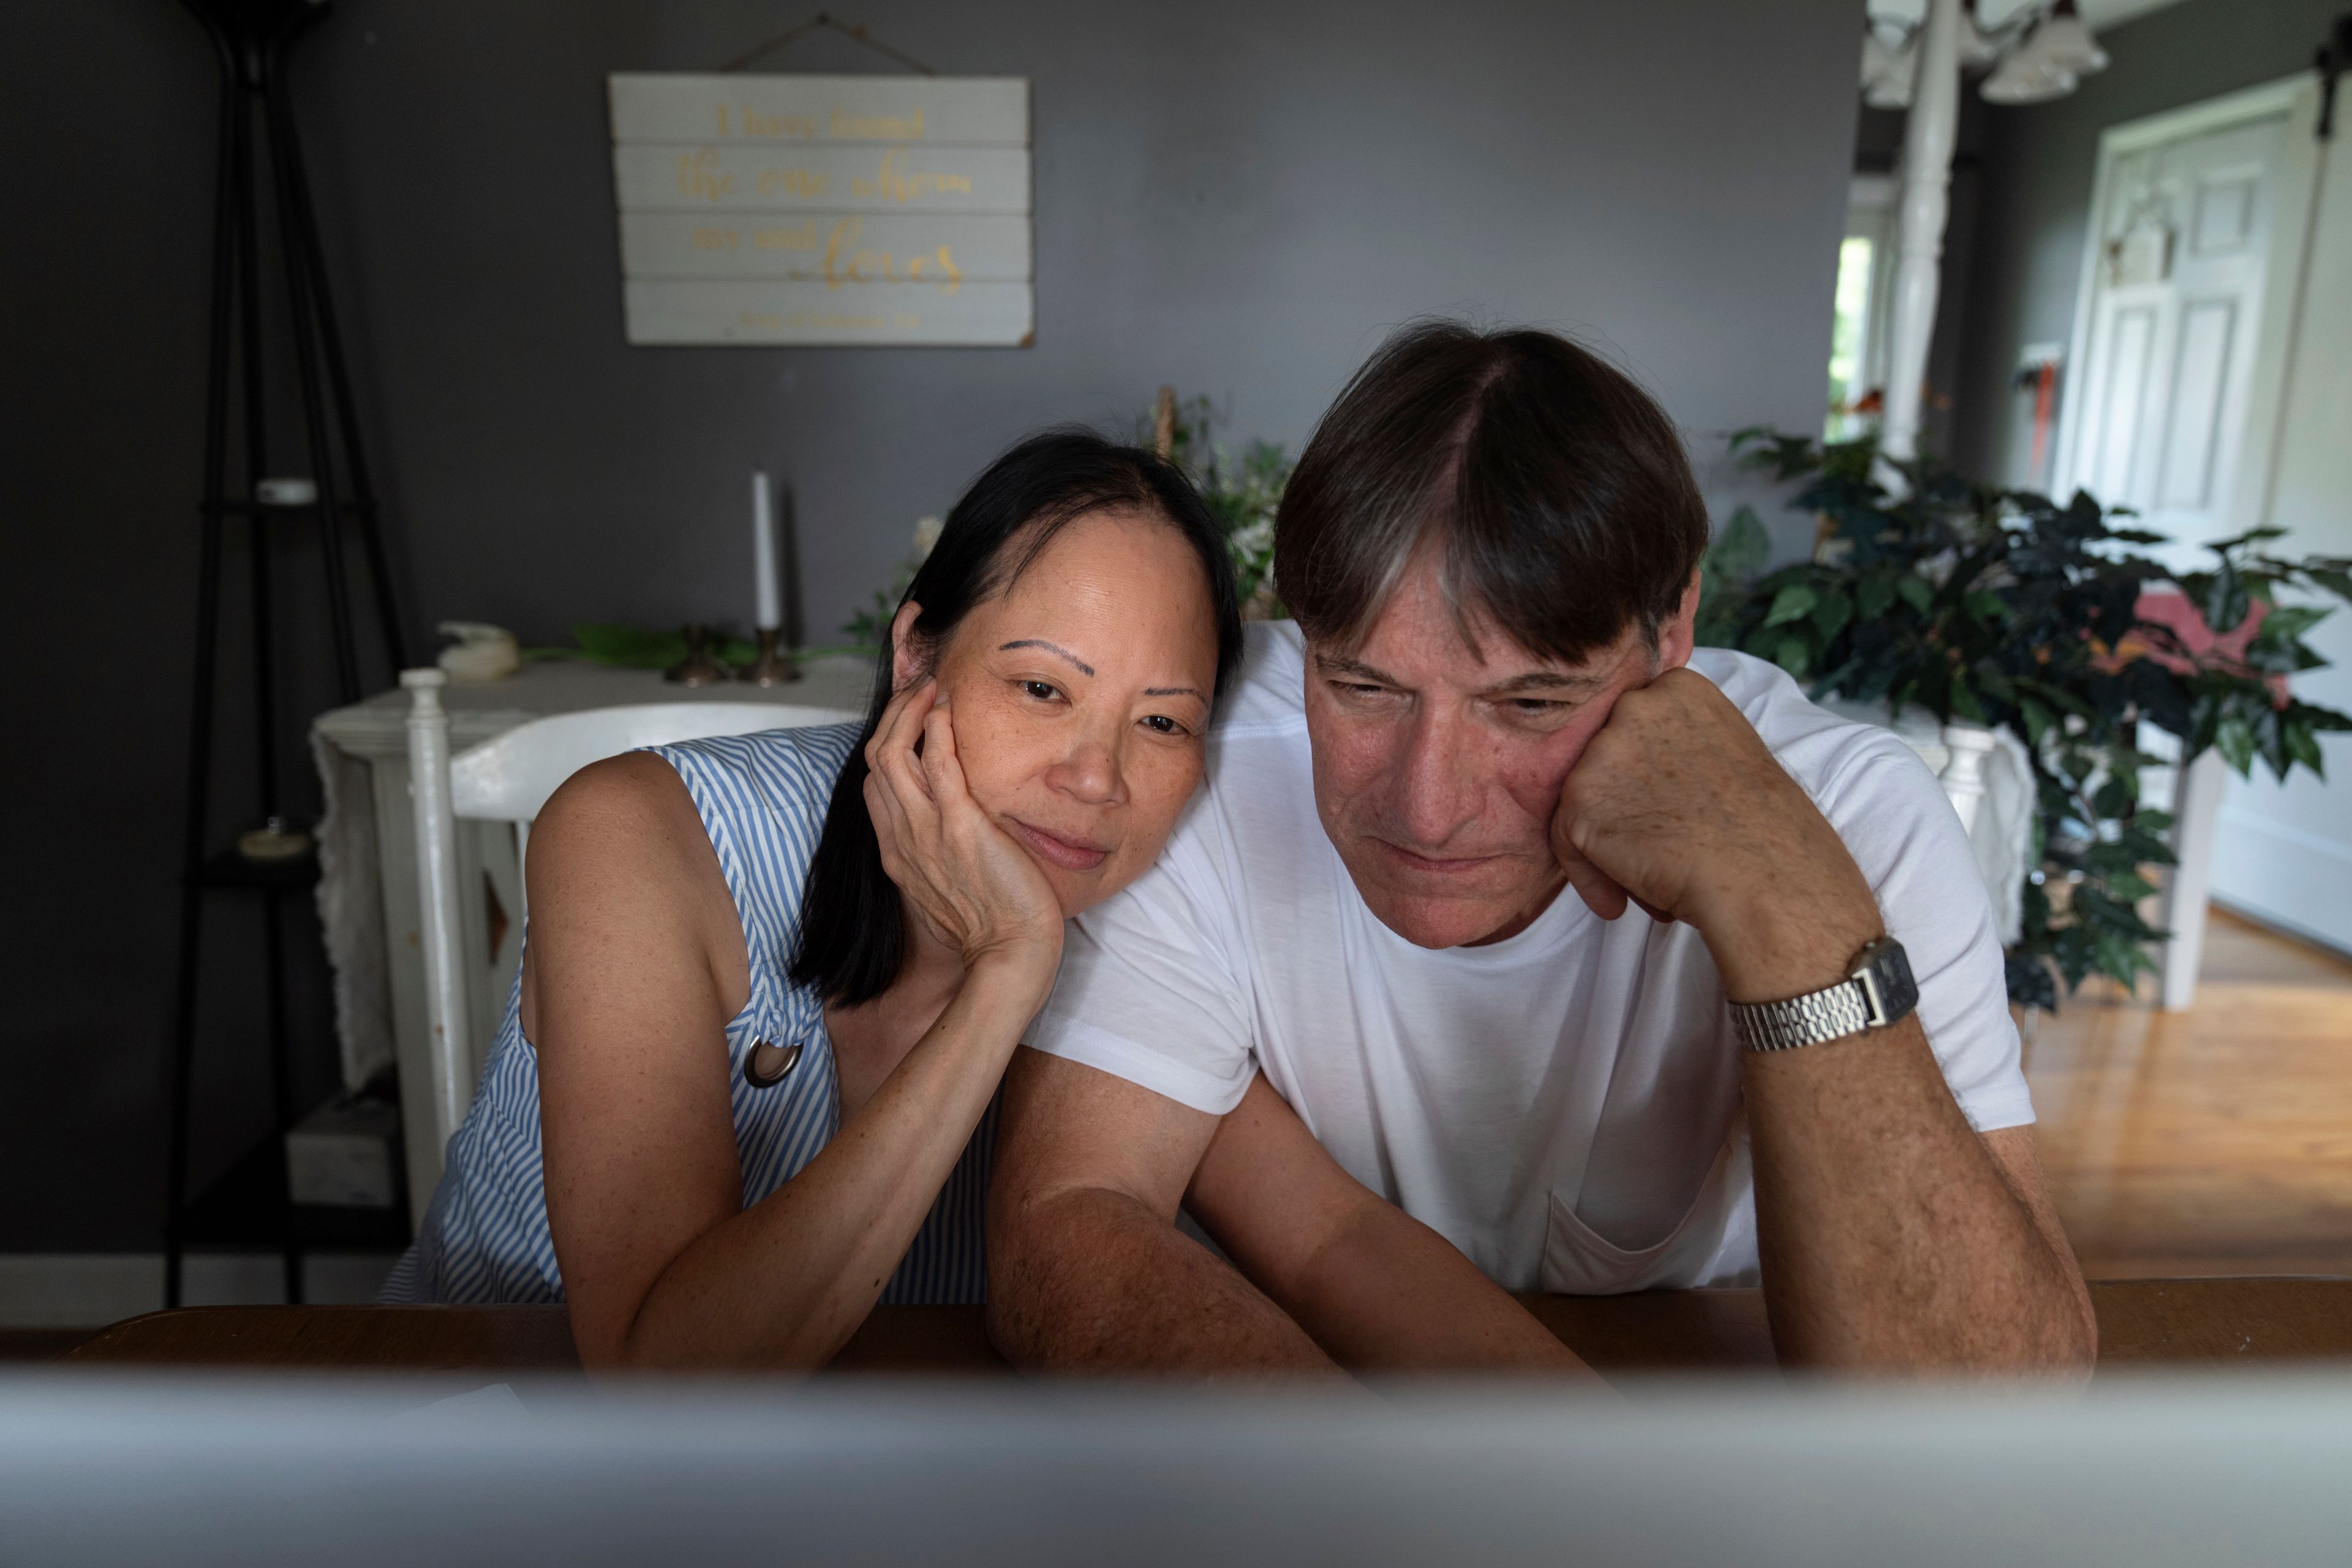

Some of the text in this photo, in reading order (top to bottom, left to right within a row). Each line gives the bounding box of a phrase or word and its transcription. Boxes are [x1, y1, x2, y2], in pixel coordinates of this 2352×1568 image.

[717, 103, 729, 137] I
[676, 146, 737, 202] the
[756, 169, 829, 200] one
[790, 217, 964, 295] loves
